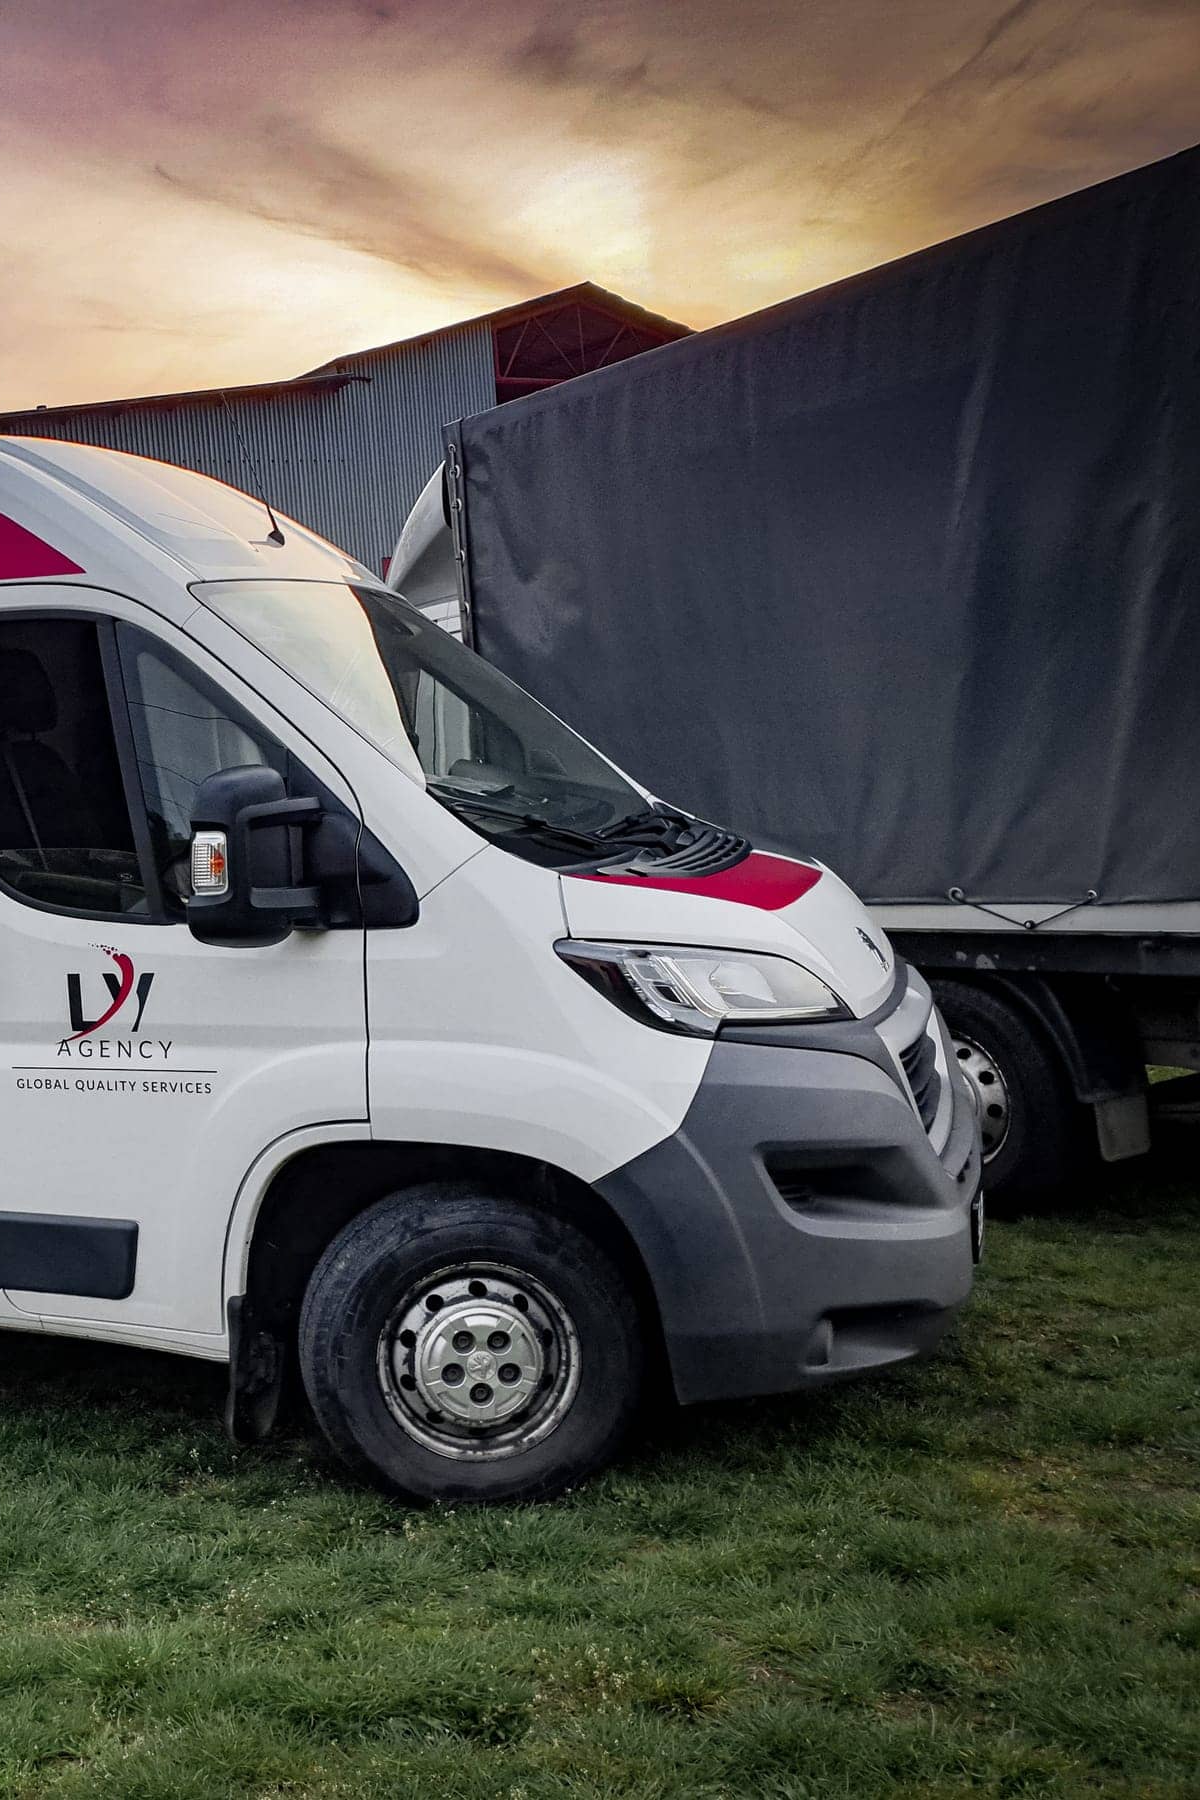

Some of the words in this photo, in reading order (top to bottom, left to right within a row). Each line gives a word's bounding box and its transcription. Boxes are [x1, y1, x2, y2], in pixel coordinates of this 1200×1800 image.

[57, 1038, 173, 1059] AGENCY
[16, 1078, 70, 1090] GLOBAL
[75, 1079, 137, 1092] QUALITY
[142, 1081, 212, 1094] SERVICES
